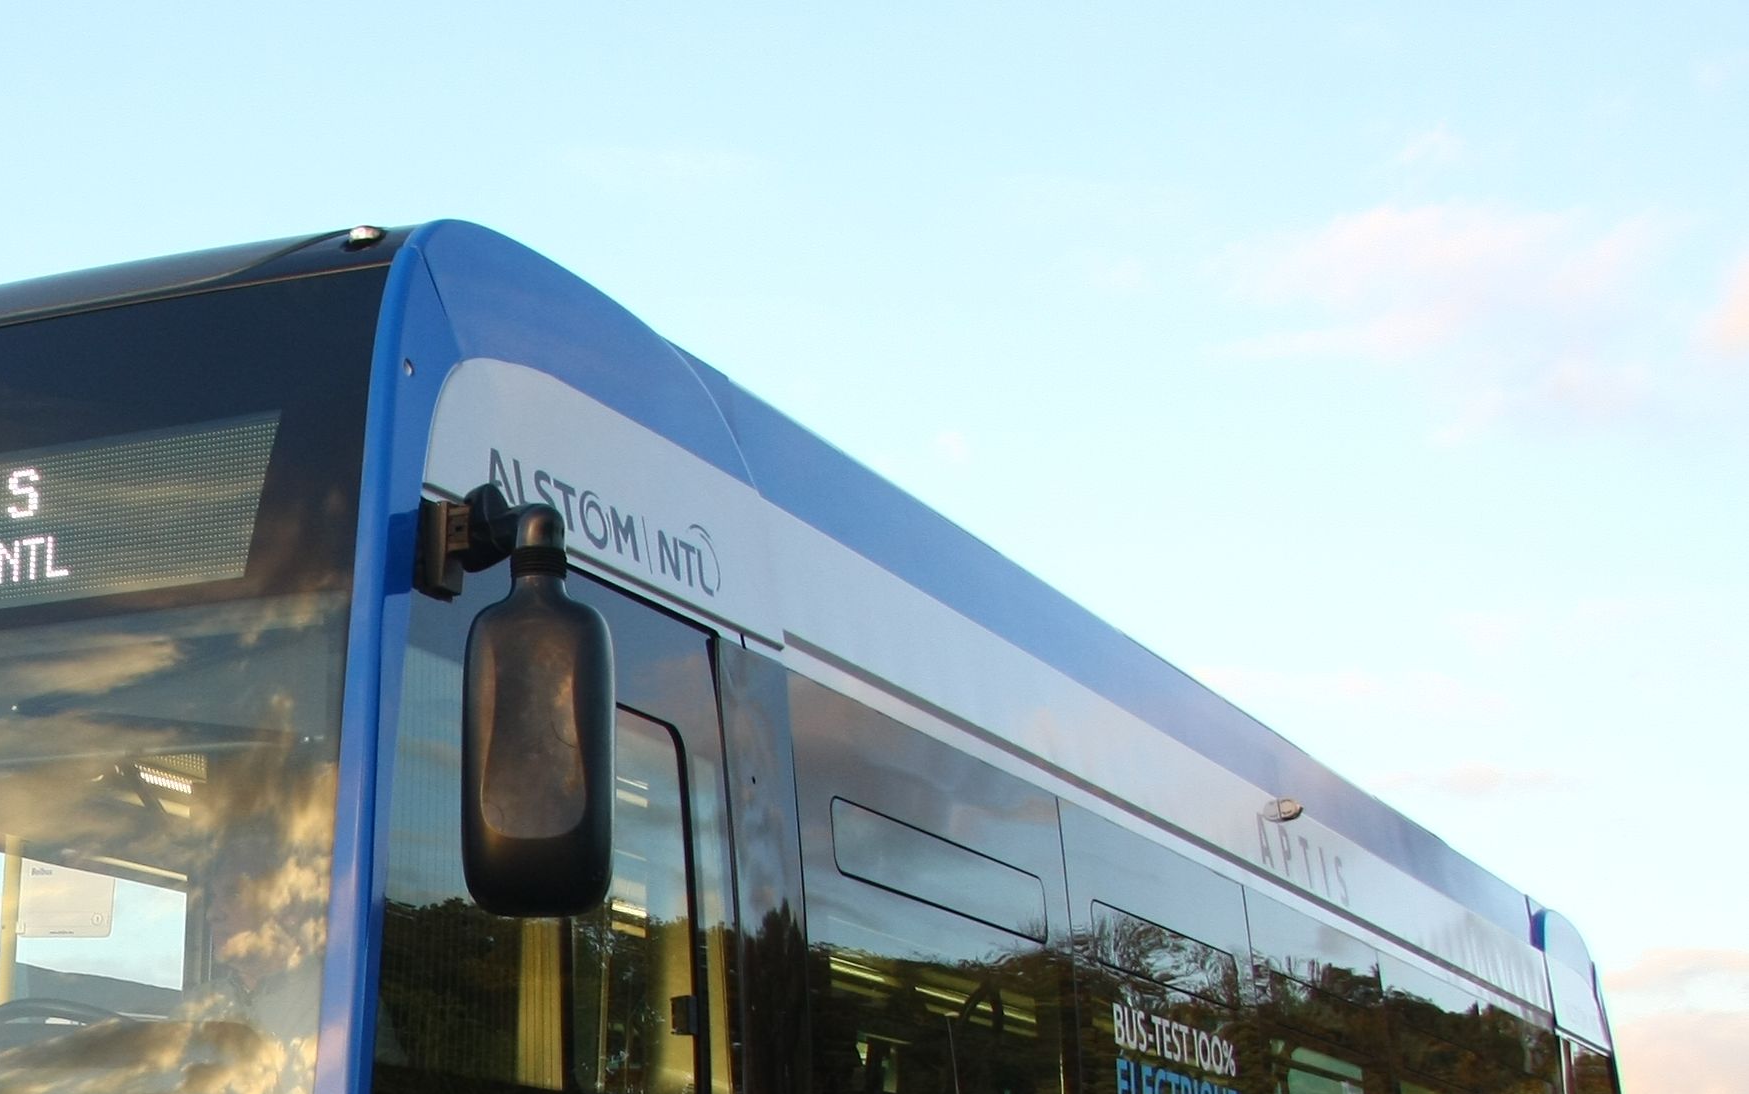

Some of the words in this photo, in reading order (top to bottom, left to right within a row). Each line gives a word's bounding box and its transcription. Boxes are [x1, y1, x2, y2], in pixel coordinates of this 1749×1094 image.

[1256, 811, 1349, 907] APTIS
[1112, 1002, 1188, 1064] BUS-TEST
[1192, 1027, 1236, 1077] 100%
